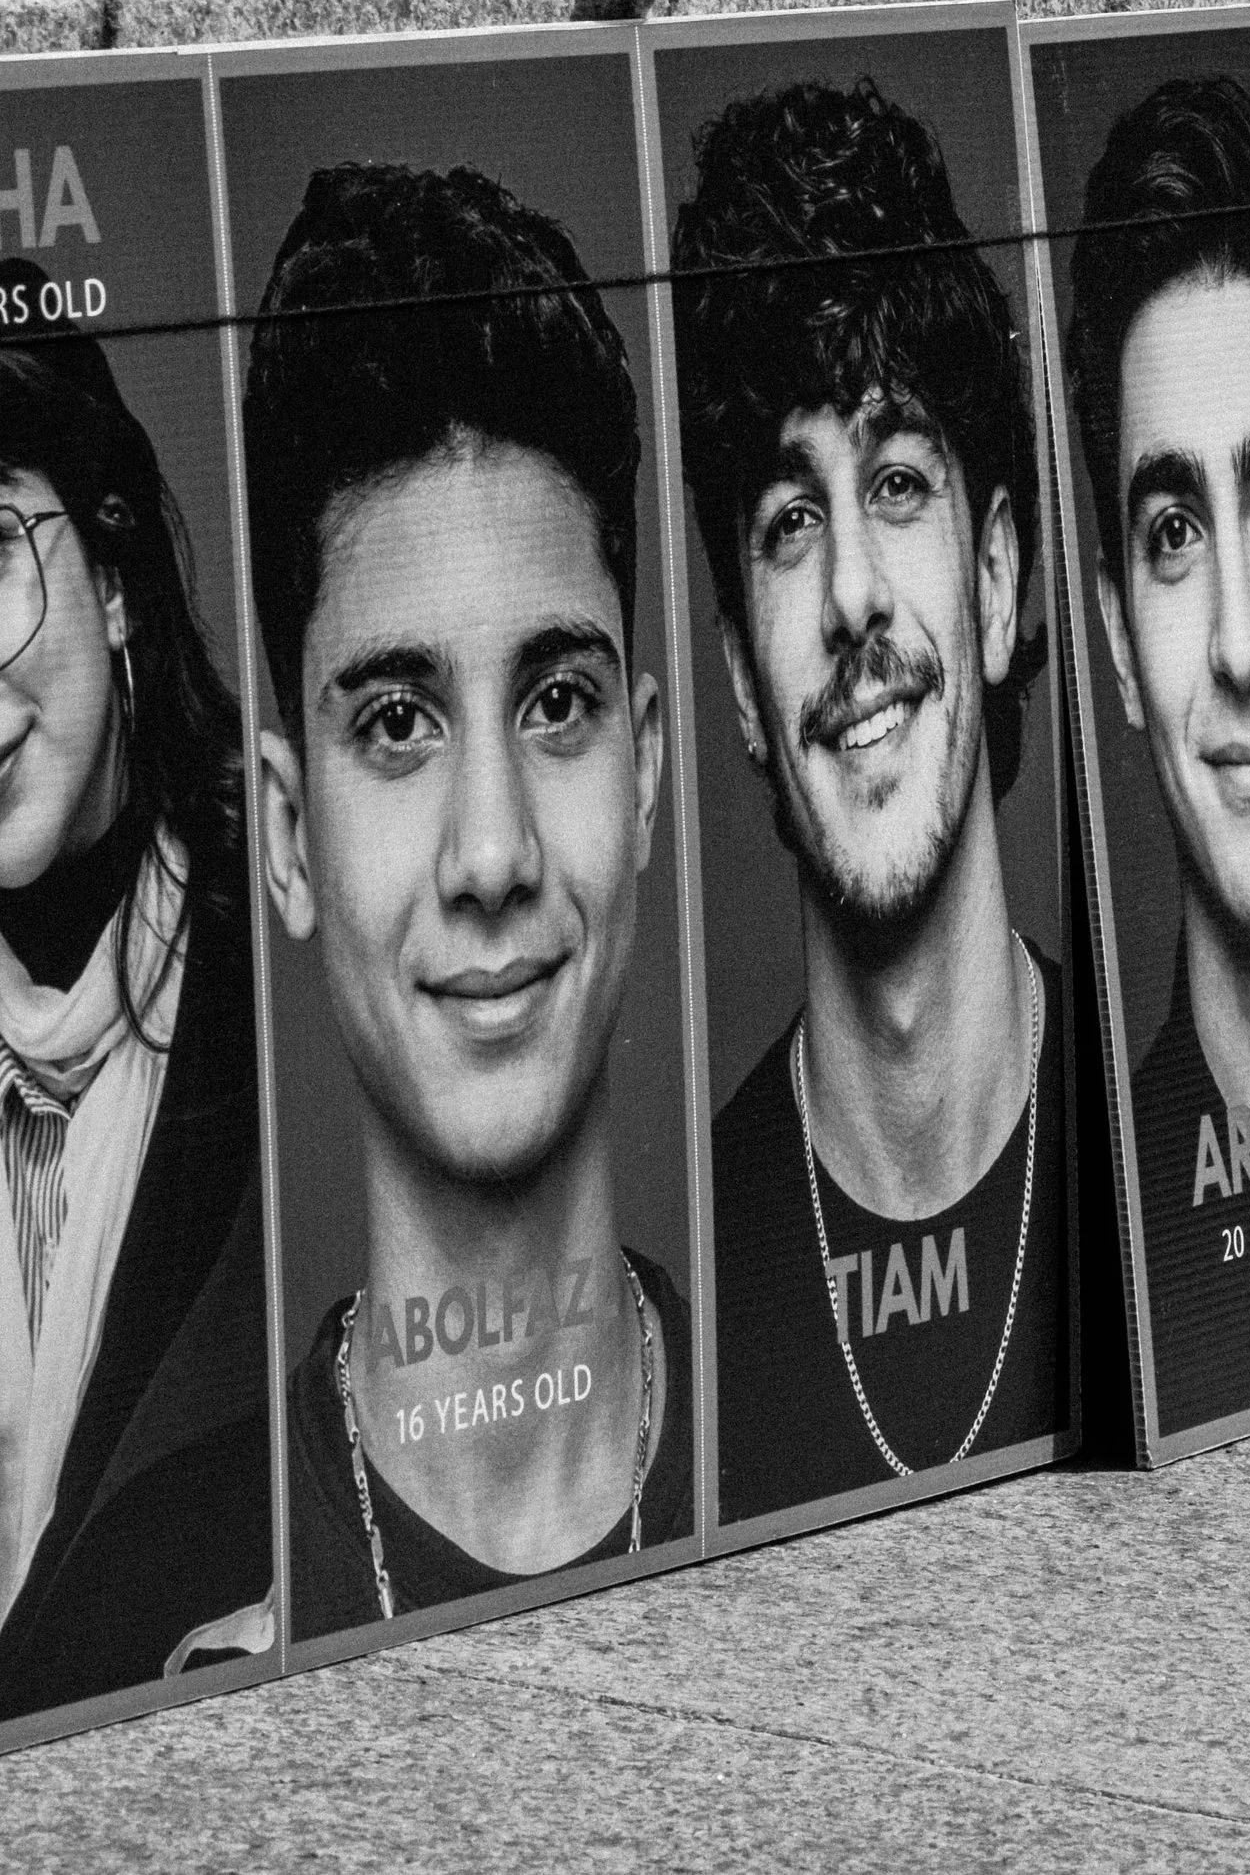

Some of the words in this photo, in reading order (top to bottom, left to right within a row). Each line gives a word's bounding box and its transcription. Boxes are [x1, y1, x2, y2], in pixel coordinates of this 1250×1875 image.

[0, 145, 102, 249] HA
[40, 278, 107, 321] OLD
[825, 1226, 970, 1345] TIAM
[1222, 1226, 1245, 1262] 20
[366, 1256, 612, 1369] ABOLFAZ
[396, 1404, 424, 1444] 16
[434, 1379, 525, 1434] YEARS
[534, 1364, 592, 1409] OLD
